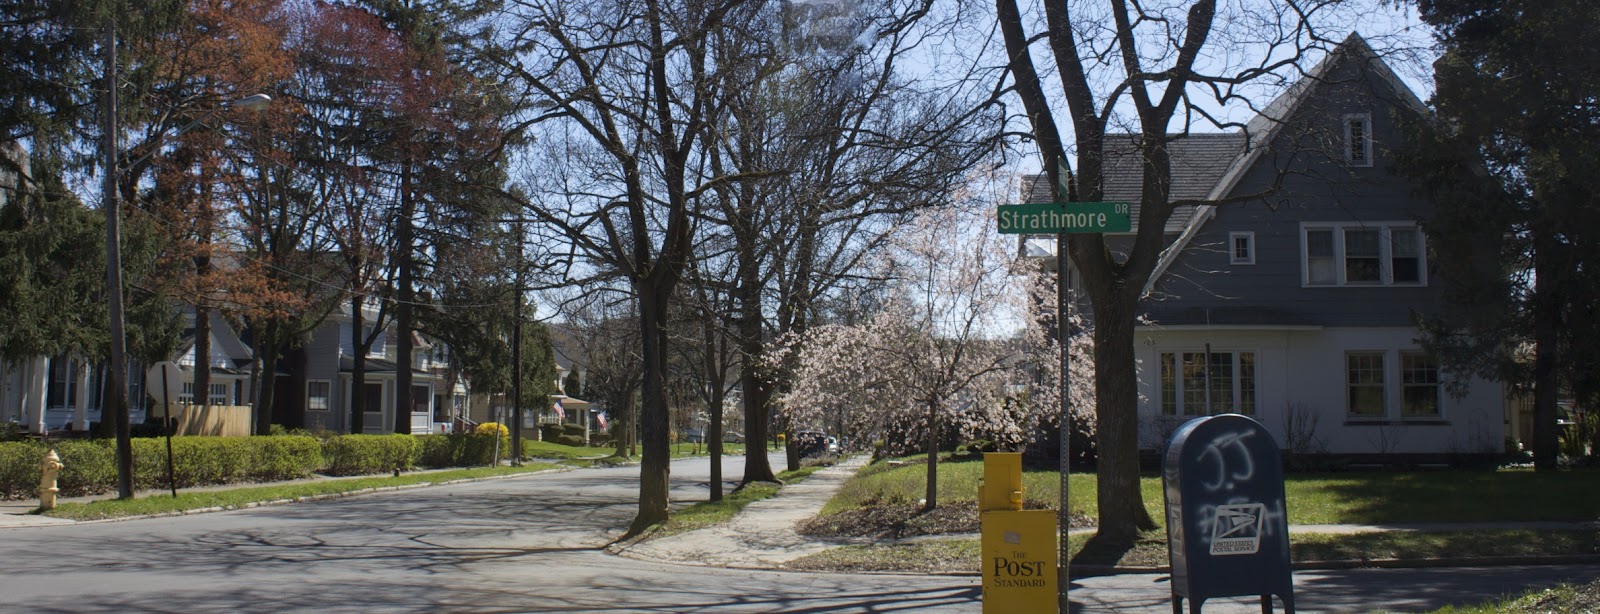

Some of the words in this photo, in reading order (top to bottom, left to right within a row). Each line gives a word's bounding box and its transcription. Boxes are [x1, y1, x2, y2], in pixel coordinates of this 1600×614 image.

[1000, 210, 1107, 230] Strathmore
[1114, 203, 1128, 214] DR
[1012, 550, 1026, 559] THE
[993, 556, 1046, 577] POST
[993, 577, 1046, 588] STANDARD
